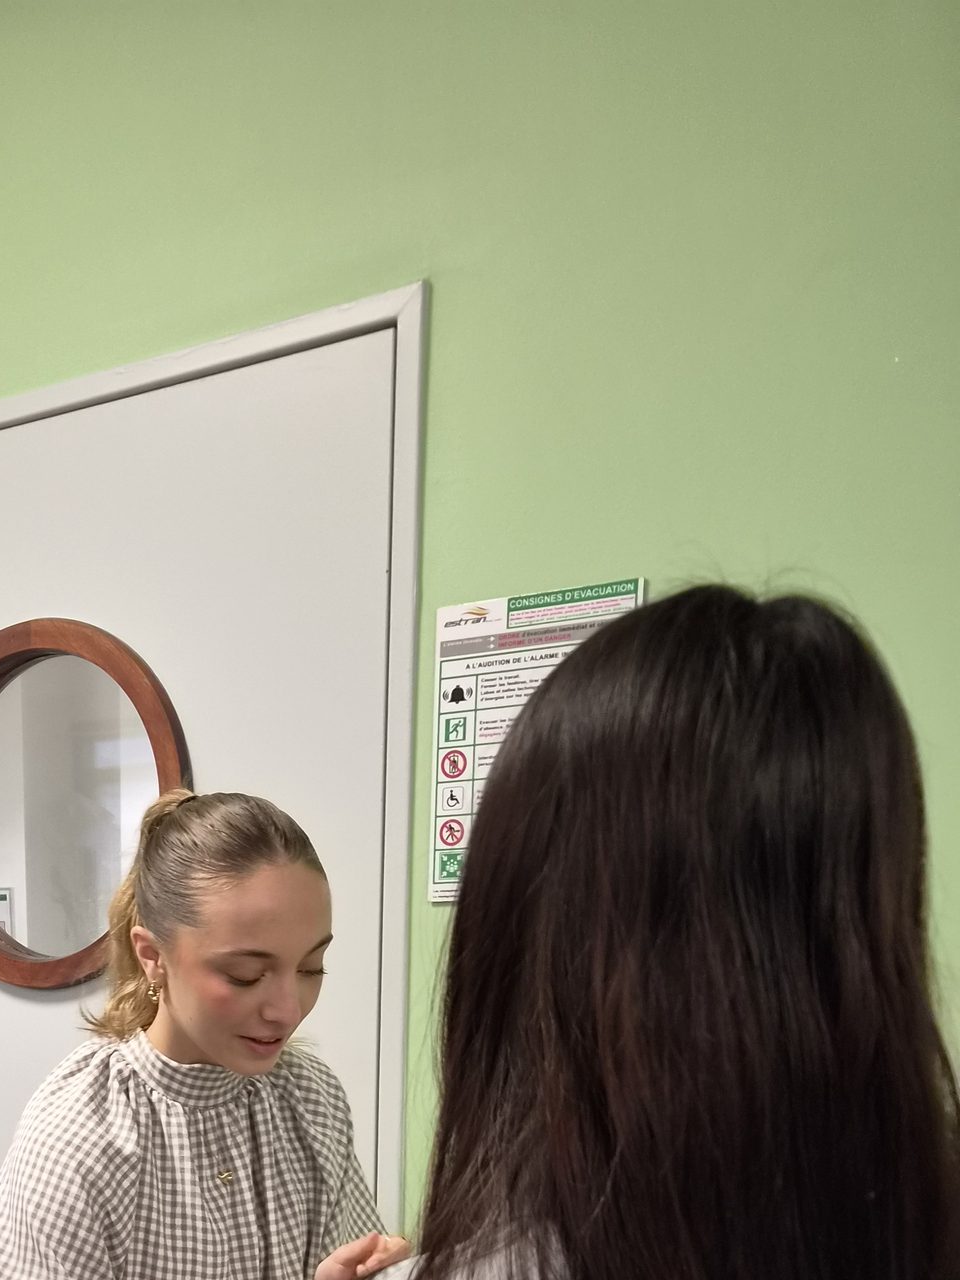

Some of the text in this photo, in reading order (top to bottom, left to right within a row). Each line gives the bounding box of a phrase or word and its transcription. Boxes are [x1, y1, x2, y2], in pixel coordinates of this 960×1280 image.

[509, 593, 563, 609] CONSIGNES
[565, 582, 635, 601] D'EVACUATION
[472, 659, 511, 669] L'AUDITION
[524, 652, 559, 663] L'ALARME
